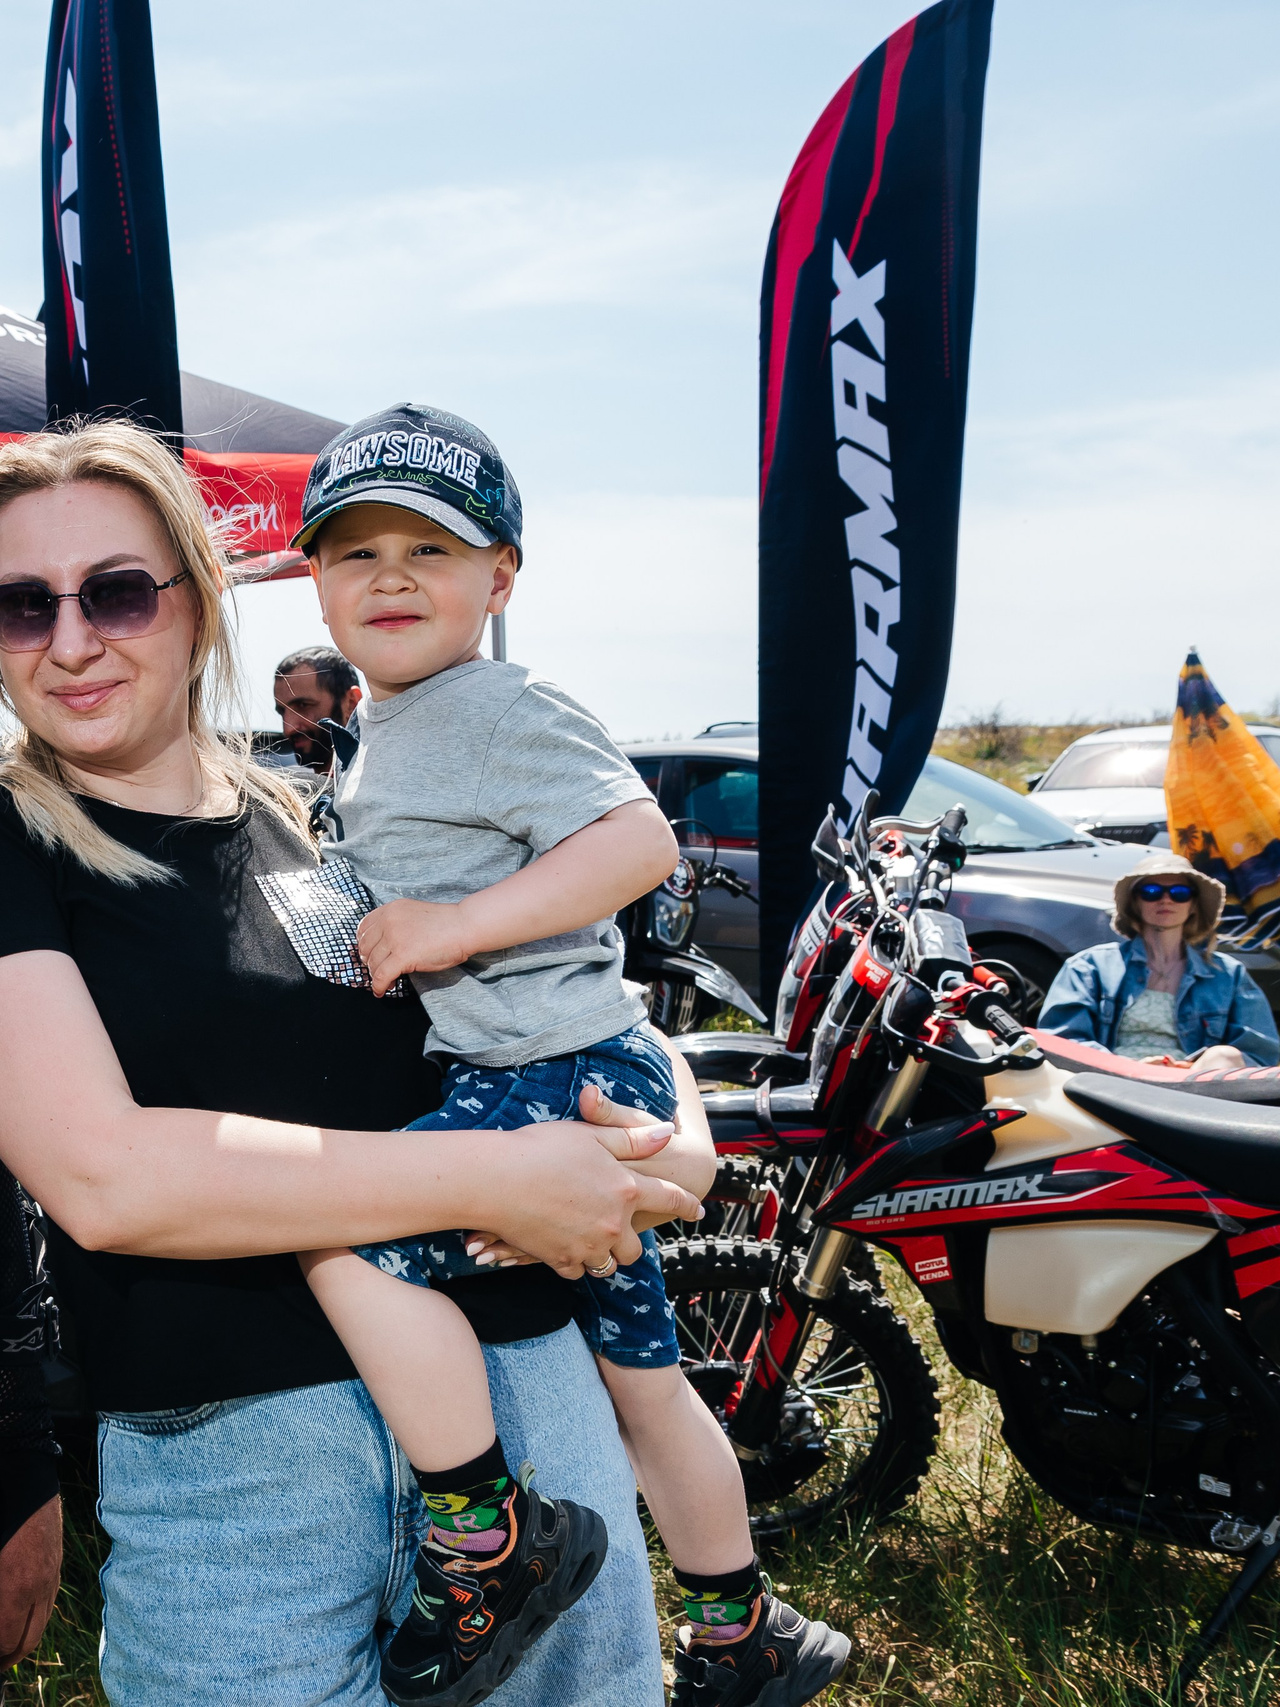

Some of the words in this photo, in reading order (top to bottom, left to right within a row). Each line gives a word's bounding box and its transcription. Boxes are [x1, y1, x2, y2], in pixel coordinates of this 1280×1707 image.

[322, 430, 481, 490] JAWSOME
[830, 238, 901, 838] HARMAX
[851, 1173, 1048, 1220] SHARMAX
[866, 1216, 905, 1226] MOTORS
[917, 1259, 946, 1270] MOTUL
[919, 1270, 950, 1281] KENDA
[452, 1513, 482, 1532] R
[701, 1603, 730, 1623] R
